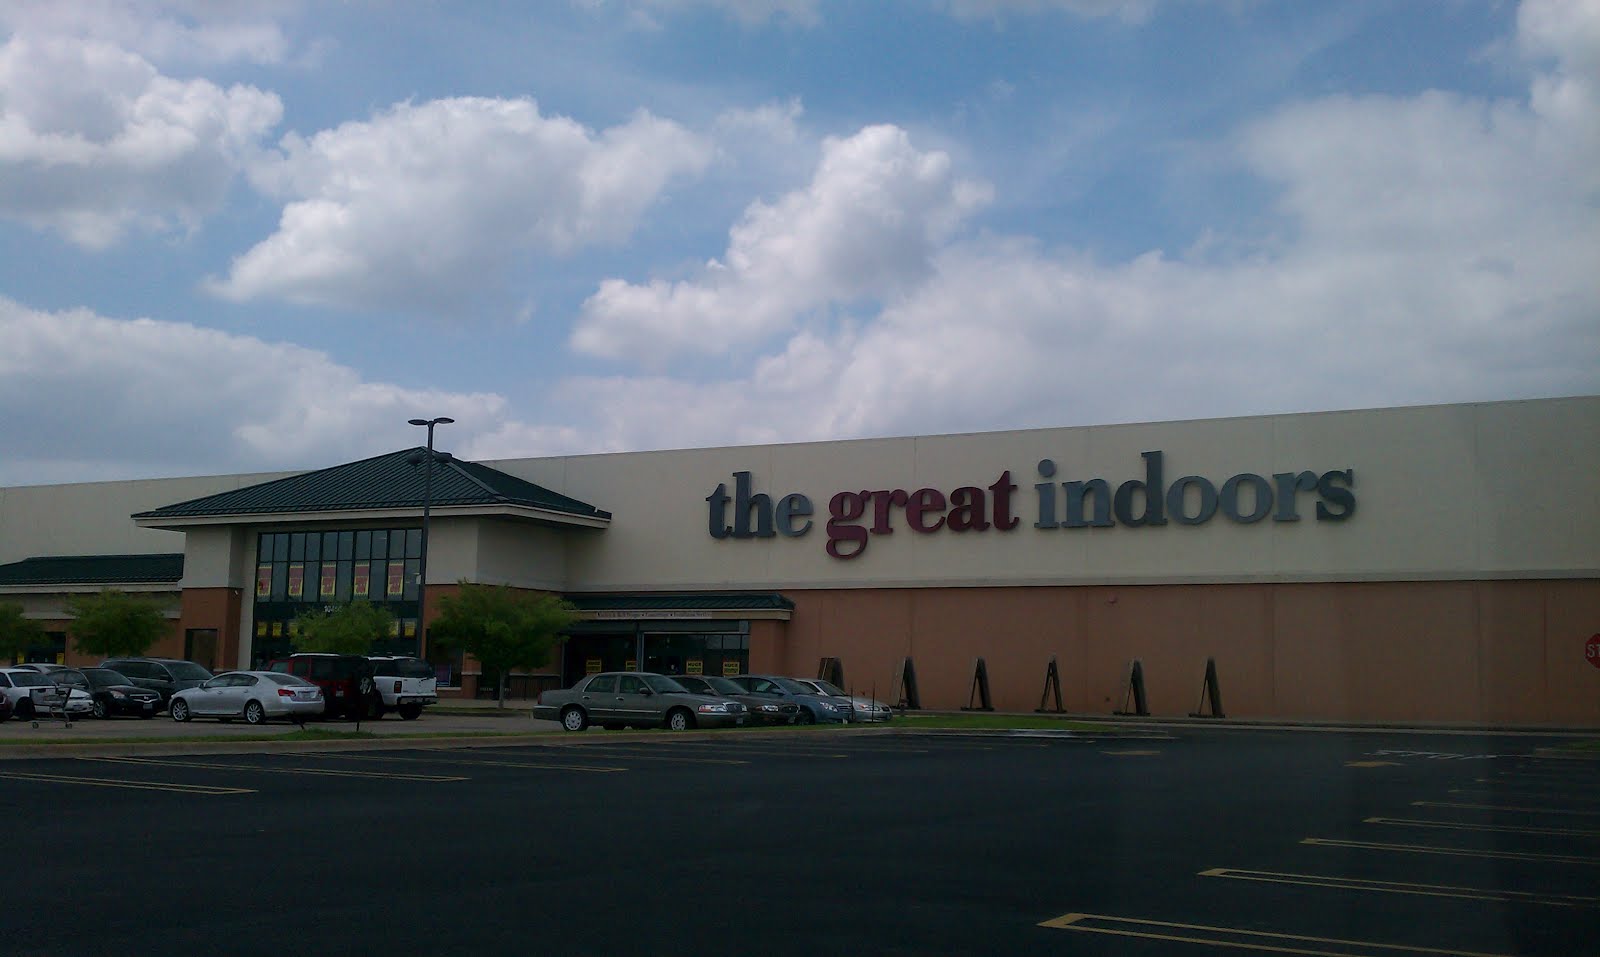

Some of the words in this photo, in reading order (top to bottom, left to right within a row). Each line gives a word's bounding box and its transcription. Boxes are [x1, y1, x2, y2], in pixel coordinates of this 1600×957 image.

[706, 471, 813, 539] the
[826, 470, 1019, 560] great
[1033, 451, 1355, 529] indoors
